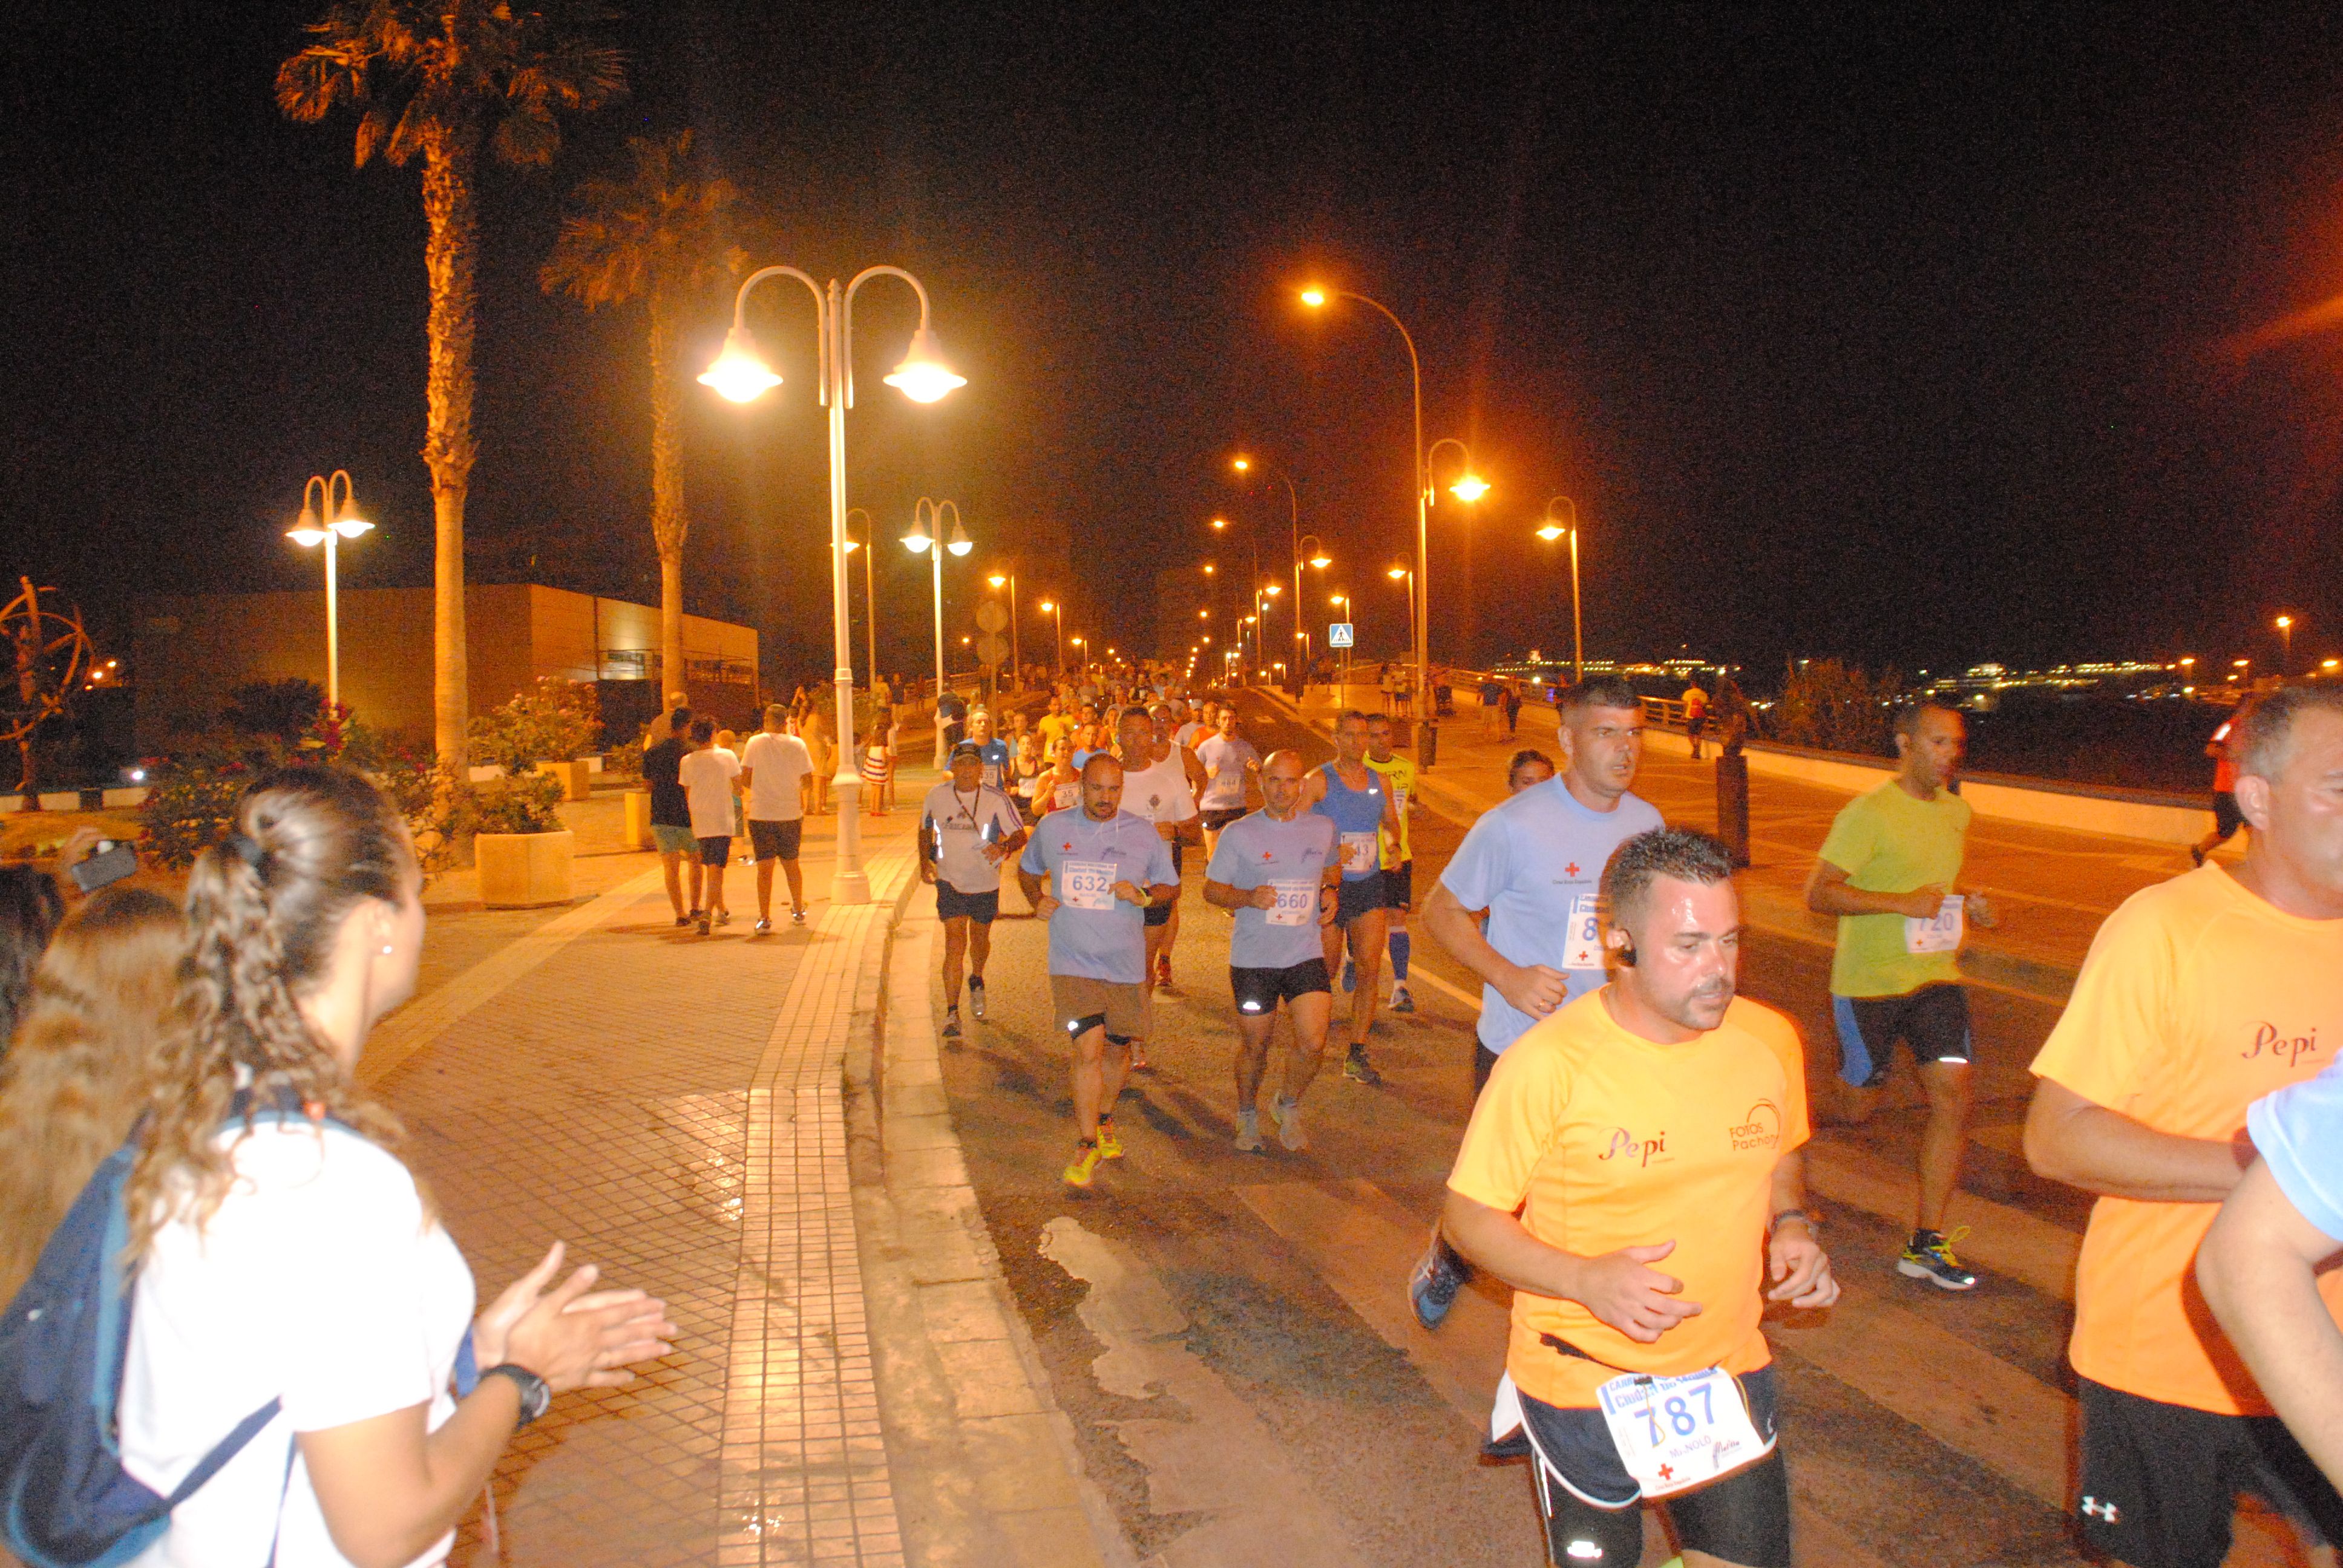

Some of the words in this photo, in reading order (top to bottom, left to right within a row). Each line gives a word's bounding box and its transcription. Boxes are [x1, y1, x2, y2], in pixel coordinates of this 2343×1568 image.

[1072, 875, 1107, 892] 632
[1277, 893, 1308, 909] 660
[2239, 1020, 2317, 1068] Pepi
[1729, 1122, 1764, 1138] FOTOS
[1598, 1126, 1666, 1168] Pepi
[1634, 1382, 1715, 1448] 787
